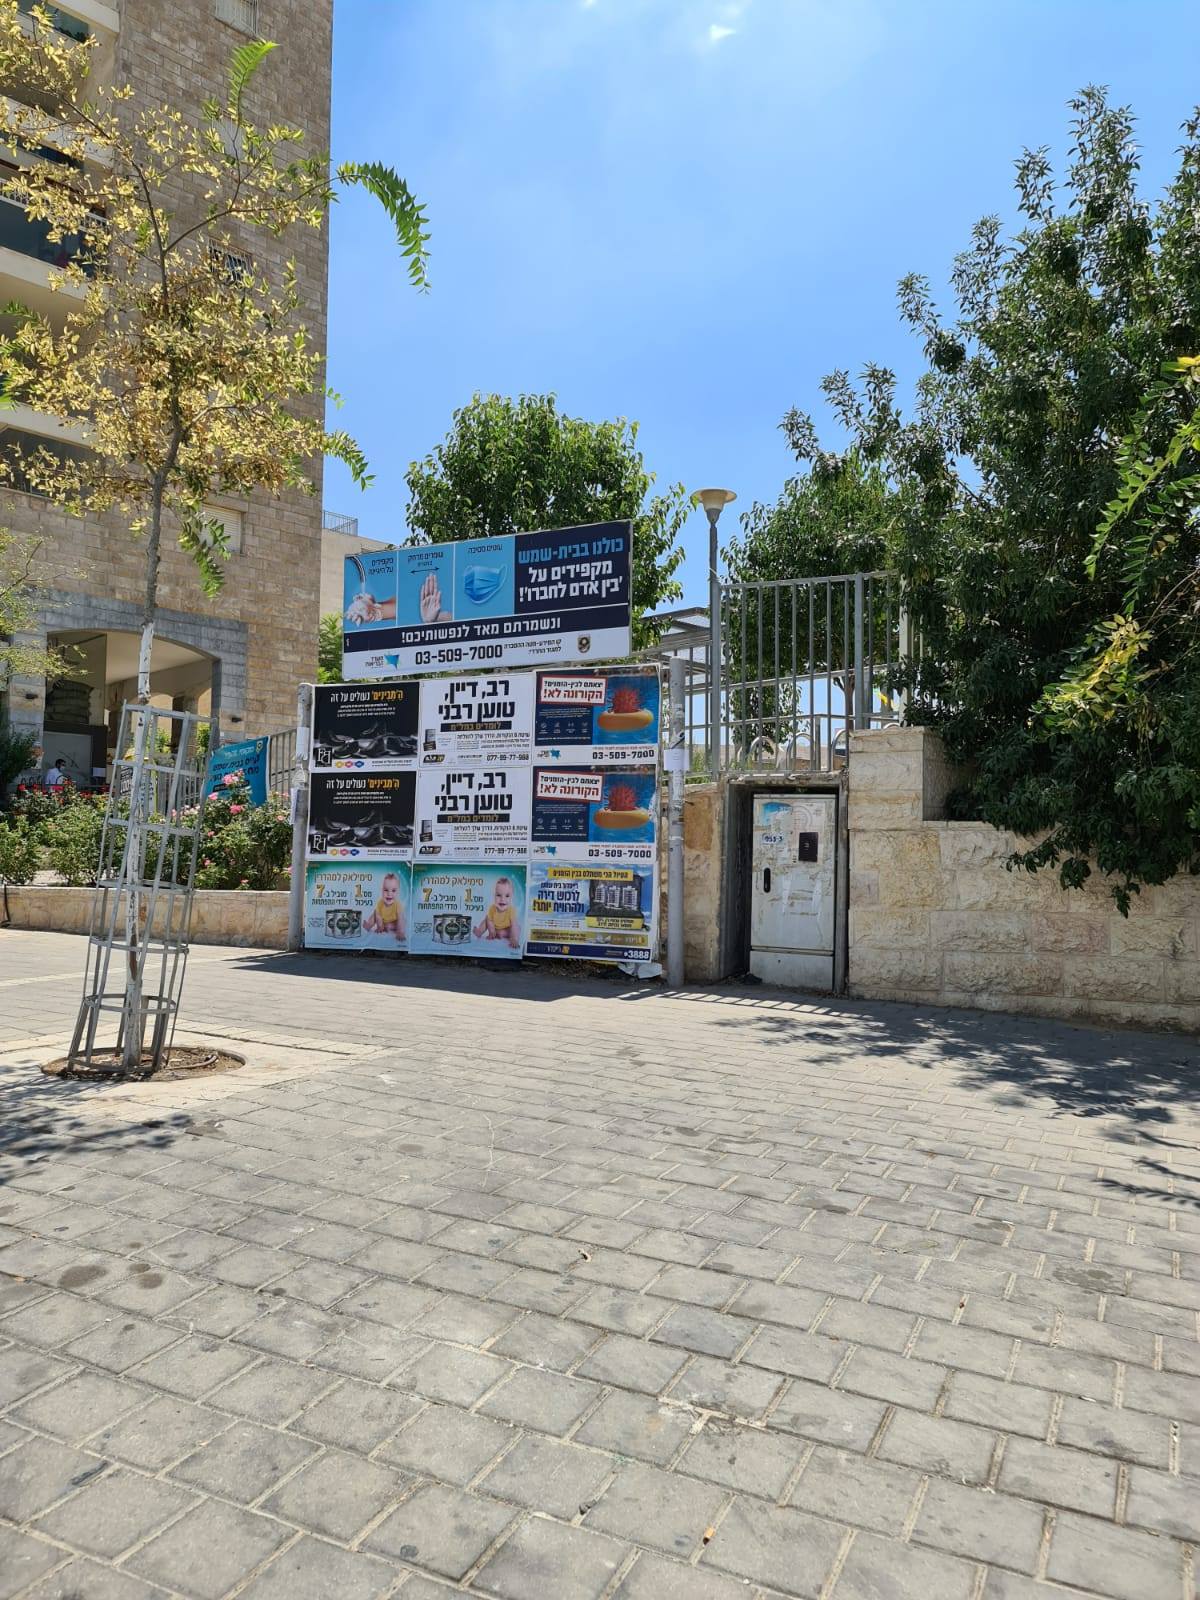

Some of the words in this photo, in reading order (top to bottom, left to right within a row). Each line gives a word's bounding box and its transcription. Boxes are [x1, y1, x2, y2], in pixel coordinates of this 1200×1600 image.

[518, 542, 591, 564] בבית-שמש
[592, 537, 624, 556] כולנו
[528, 566, 548, 584] על
[551, 560, 613, 581] מקפידים
[519, 581, 567, 603] לחברו'!
[569, 580, 599, 597] אדם
[401, 624, 470, 644] לנפשותיכם!
[473, 623, 499, 636] מאד
[503, 617, 561, 634] ונשמרתם
[415, 644, 503, 666] 03-509-7000
[330, 692, 340, 703] זה
[340, 691, 349, 702] על
[444, 681, 478, 704] דיין,
[482, 680, 510, 700] רב,
[543, 688, 562, 698] לא!
[563, 689, 603, 701] הקורונה
[438, 703, 473, 720] רבני
[477, 701, 516, 723] טוען
[592, 749, 655, 760] 03-509-7000
[326, 779, 335, 790] זה
[336, 778, 345, 789] על
[441, 773, 475, 795] דיין,
[478, 772, 507, 792] רב,
[540, 784, 559, 794] לא!
[560, 786, 600, 798] הקורונה
[434, 795, 470, 812] רבני
[474, 794, 513, 815] טוען
[588, 848, 652, 859] 03-509-7000
[332, 890, 348, 898] מוביל
[440, 894, 456, 902] מוביל
